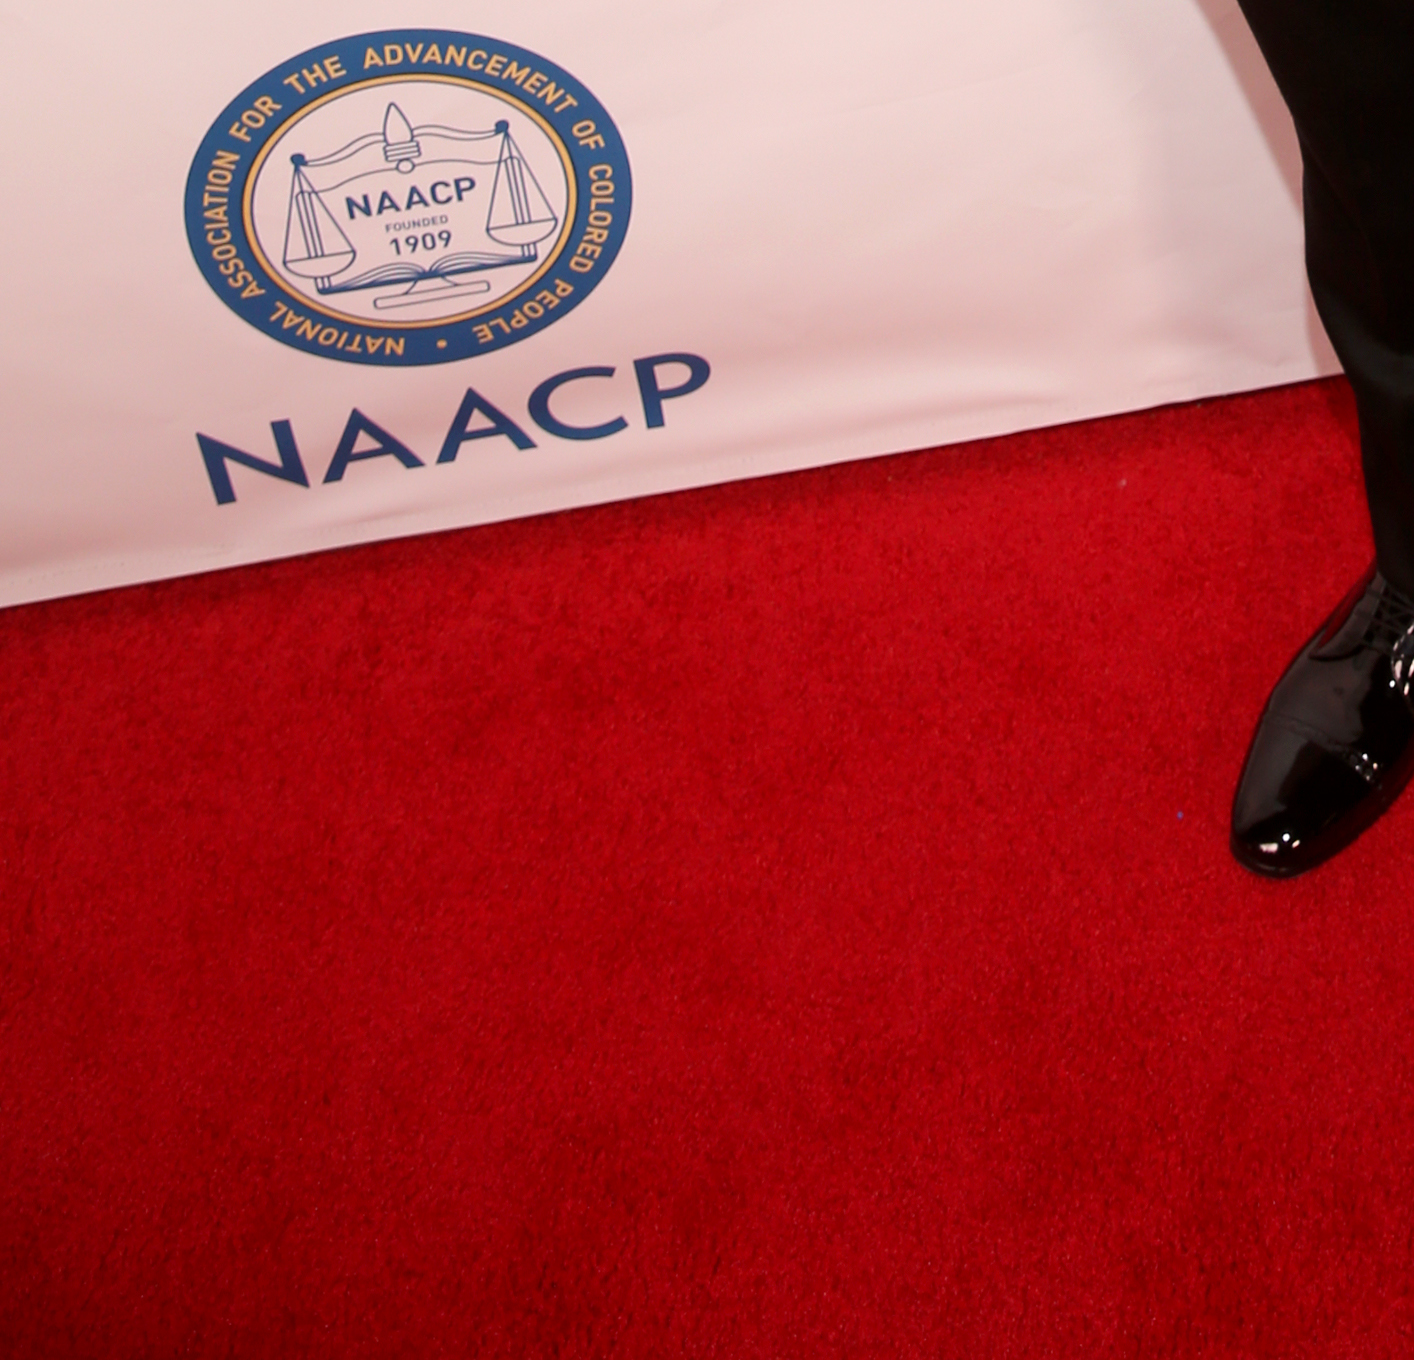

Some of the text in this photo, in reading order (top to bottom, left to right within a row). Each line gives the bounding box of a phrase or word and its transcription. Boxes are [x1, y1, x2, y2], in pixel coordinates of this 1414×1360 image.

[203, 42, 615, 357] NATIONAL ASSOCIATION FOR THE ADVANCEMENT OF COLORED PEOPLE
[345, 176, 476, 220] NAACP
[385, 214, 449, 233] FOUNDED
[389, 229, 452, 256] 1909
[195, 352, 711, 506] NAACP
